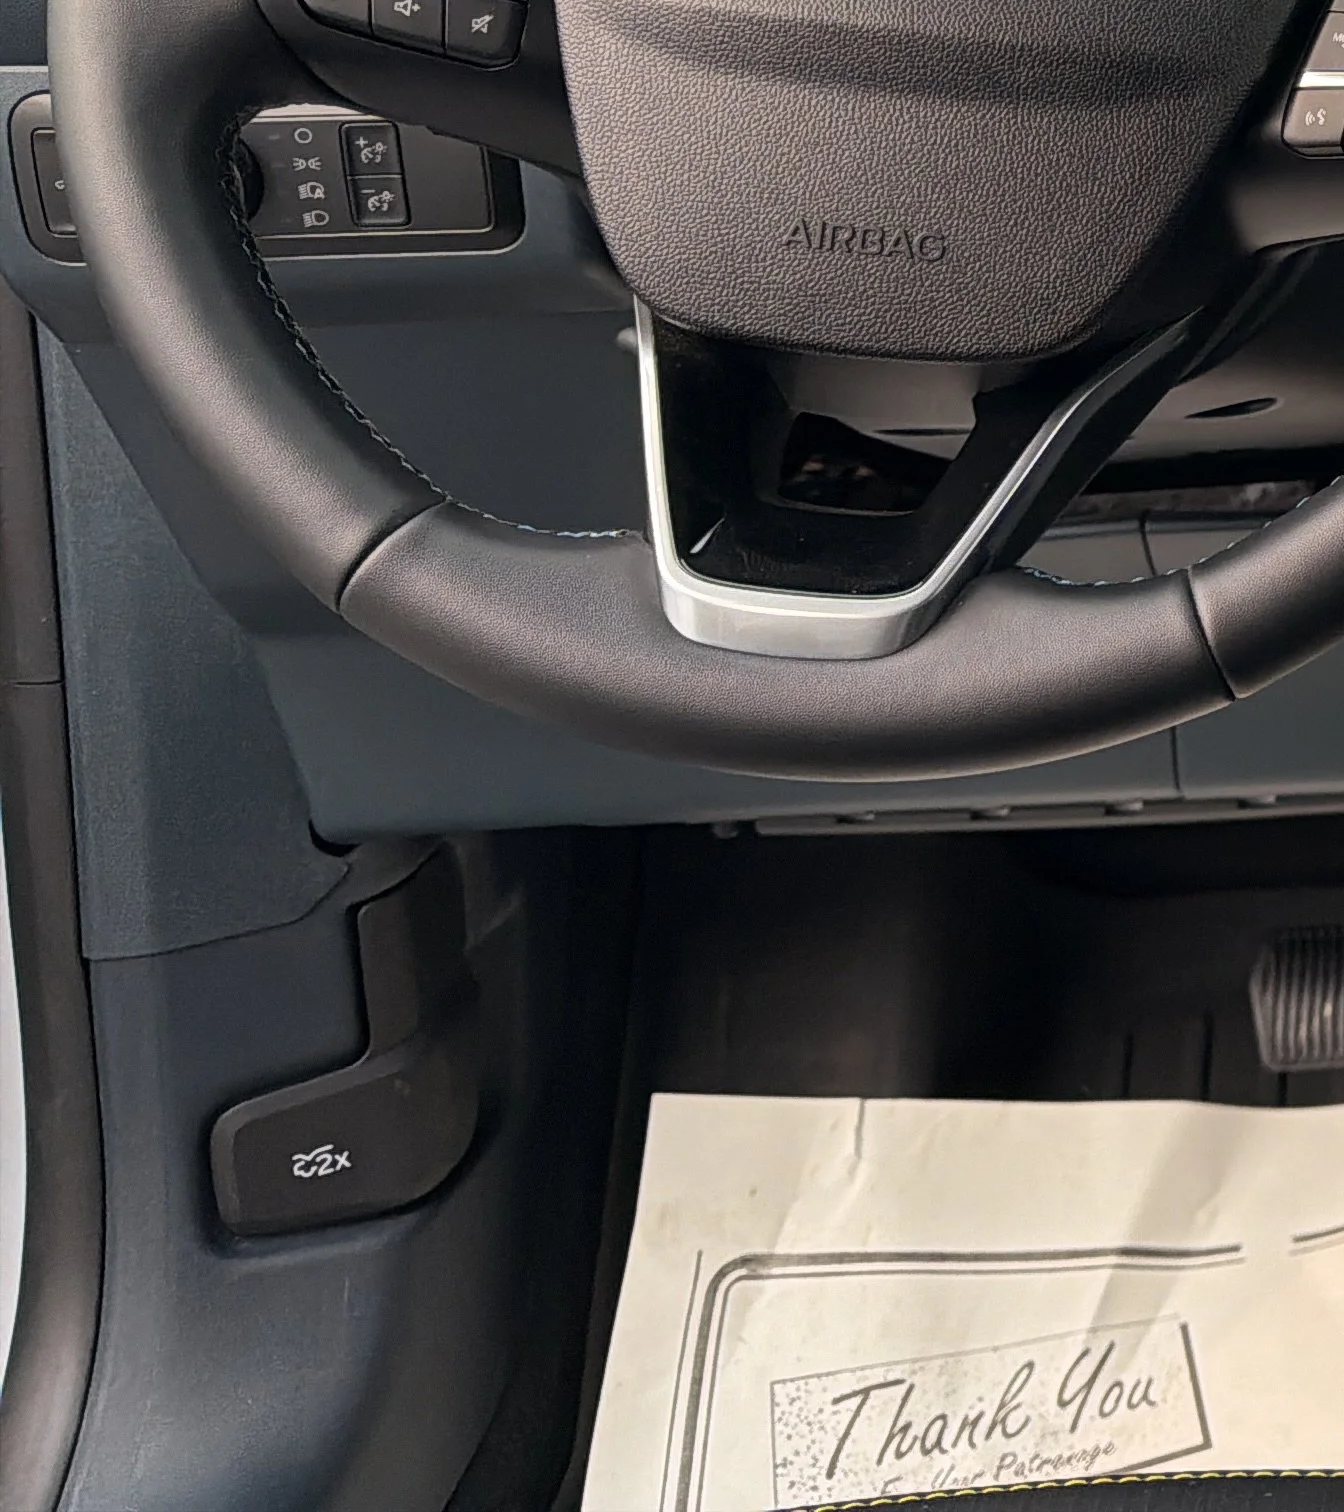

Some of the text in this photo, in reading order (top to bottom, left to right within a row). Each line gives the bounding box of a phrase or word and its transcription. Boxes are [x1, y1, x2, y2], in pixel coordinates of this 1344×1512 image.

[782, 218, 948, 262] AIRBAG
[826, 1340, 1157, 1480] Thank You
